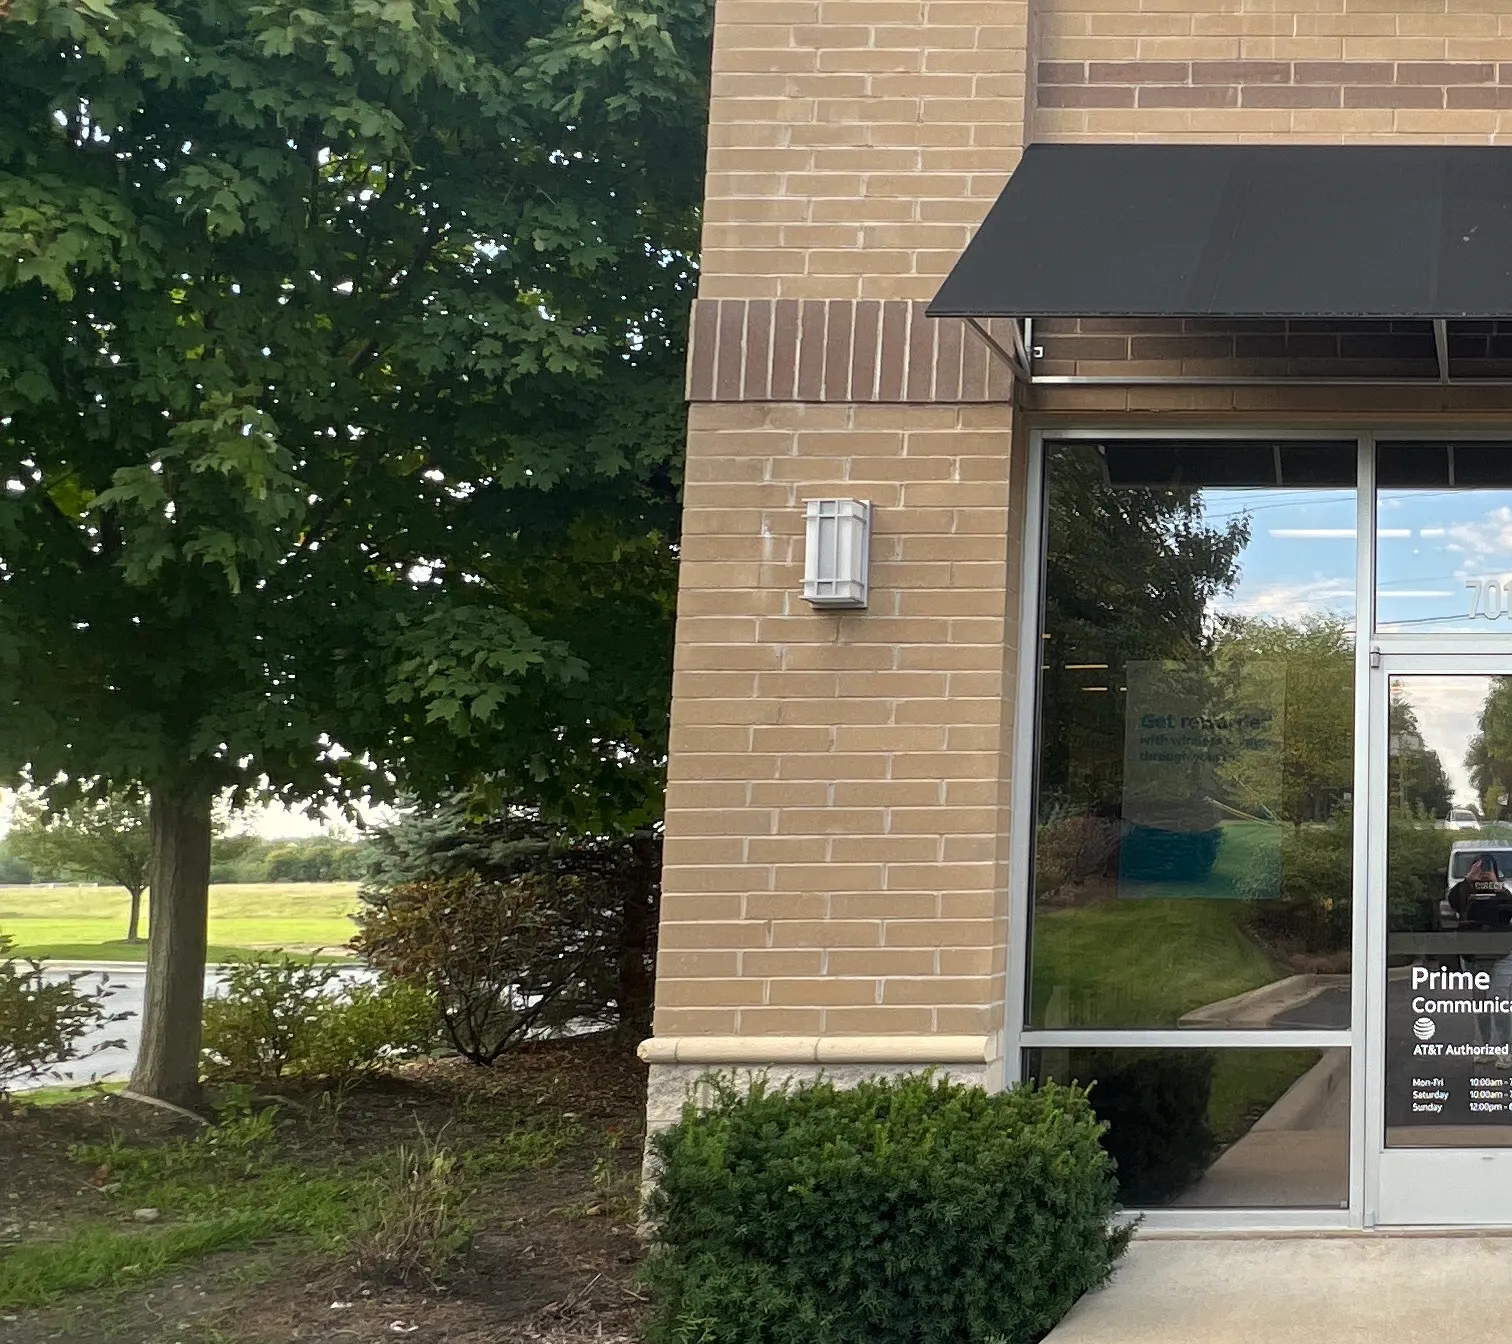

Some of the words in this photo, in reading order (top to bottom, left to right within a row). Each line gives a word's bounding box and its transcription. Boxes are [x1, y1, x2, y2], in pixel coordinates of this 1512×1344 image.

[1411, 966, 1491, 990] Prime
[1413, 1044, 1444, 1056] AT&T
[1445, 1044, 1509, 1056] Authorized
[1412, 1077, 1445, 1087] Mon-Fri
[1469, 1077, 1503, 1087] 10:00am
[1412, 1090, 1449, 1100] Saturday
[1469, 1090, 1503, 1099] 10:00am
[1412, 1102, 1443, 1113] Sunday
[1469, 1102, 1503, 1113] 12:00pm
